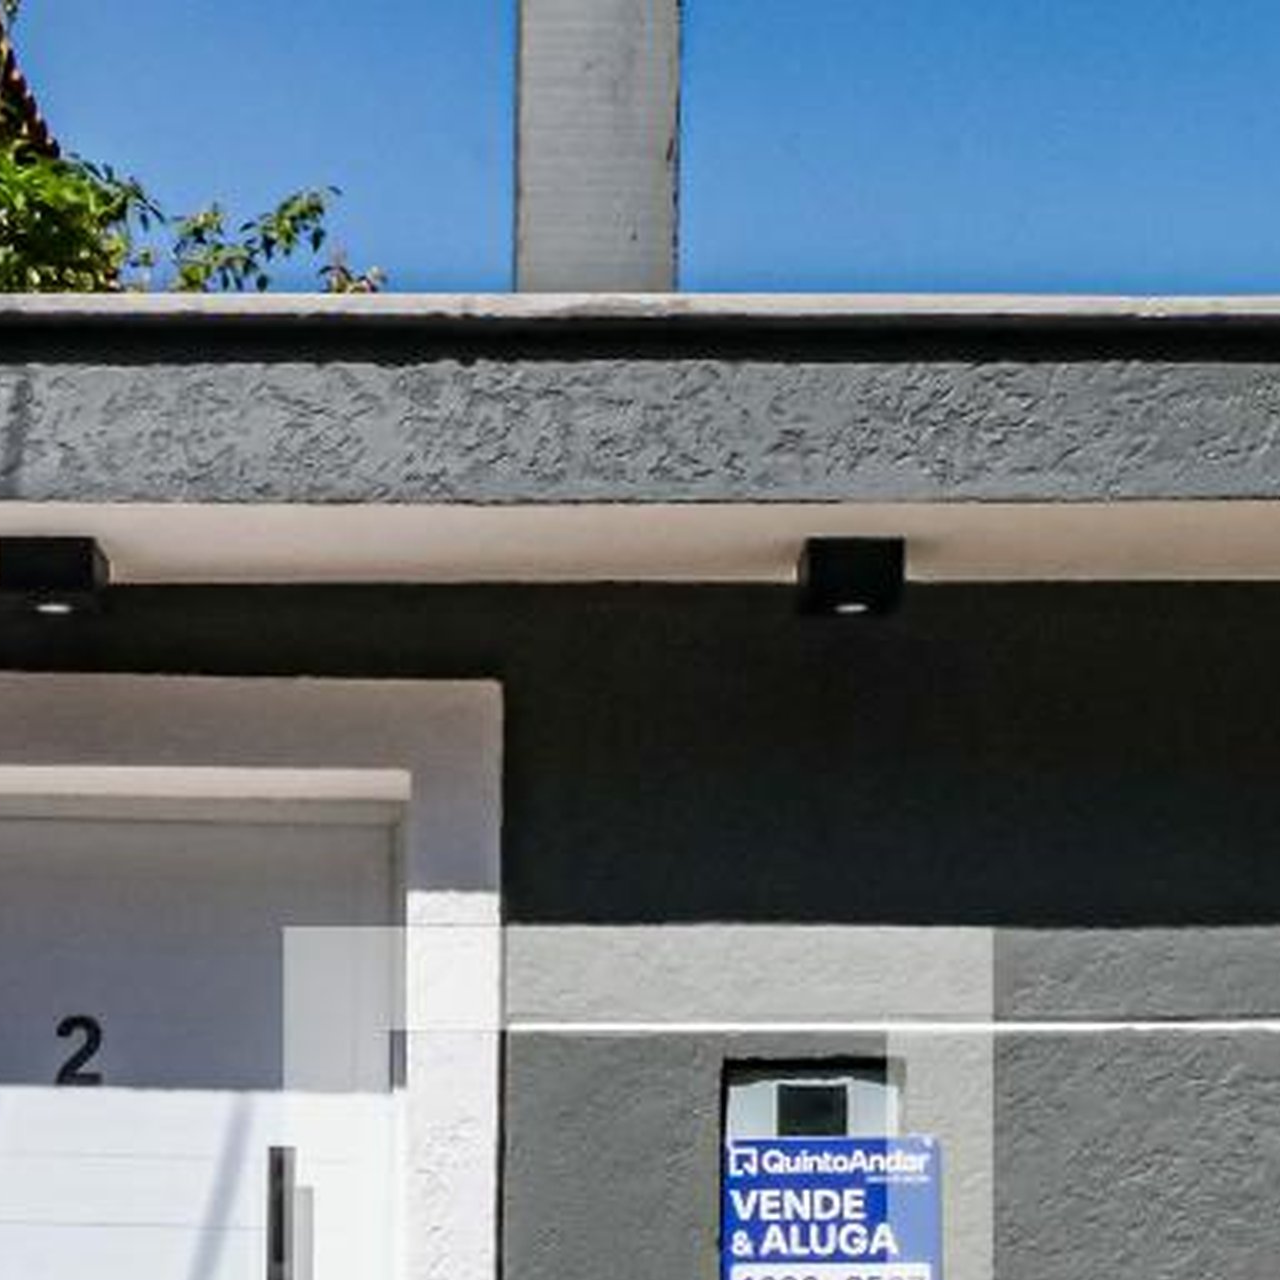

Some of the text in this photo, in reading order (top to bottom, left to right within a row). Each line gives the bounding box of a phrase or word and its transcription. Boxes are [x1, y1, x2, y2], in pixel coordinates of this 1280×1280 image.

[55, 1014, 102, 1086] 2
[761, 1149, 931, 1173] QuintoAndar
[729, 1188, 868, 1221] VENDE
[731, 1222, 899, 1256] & ALUGA
